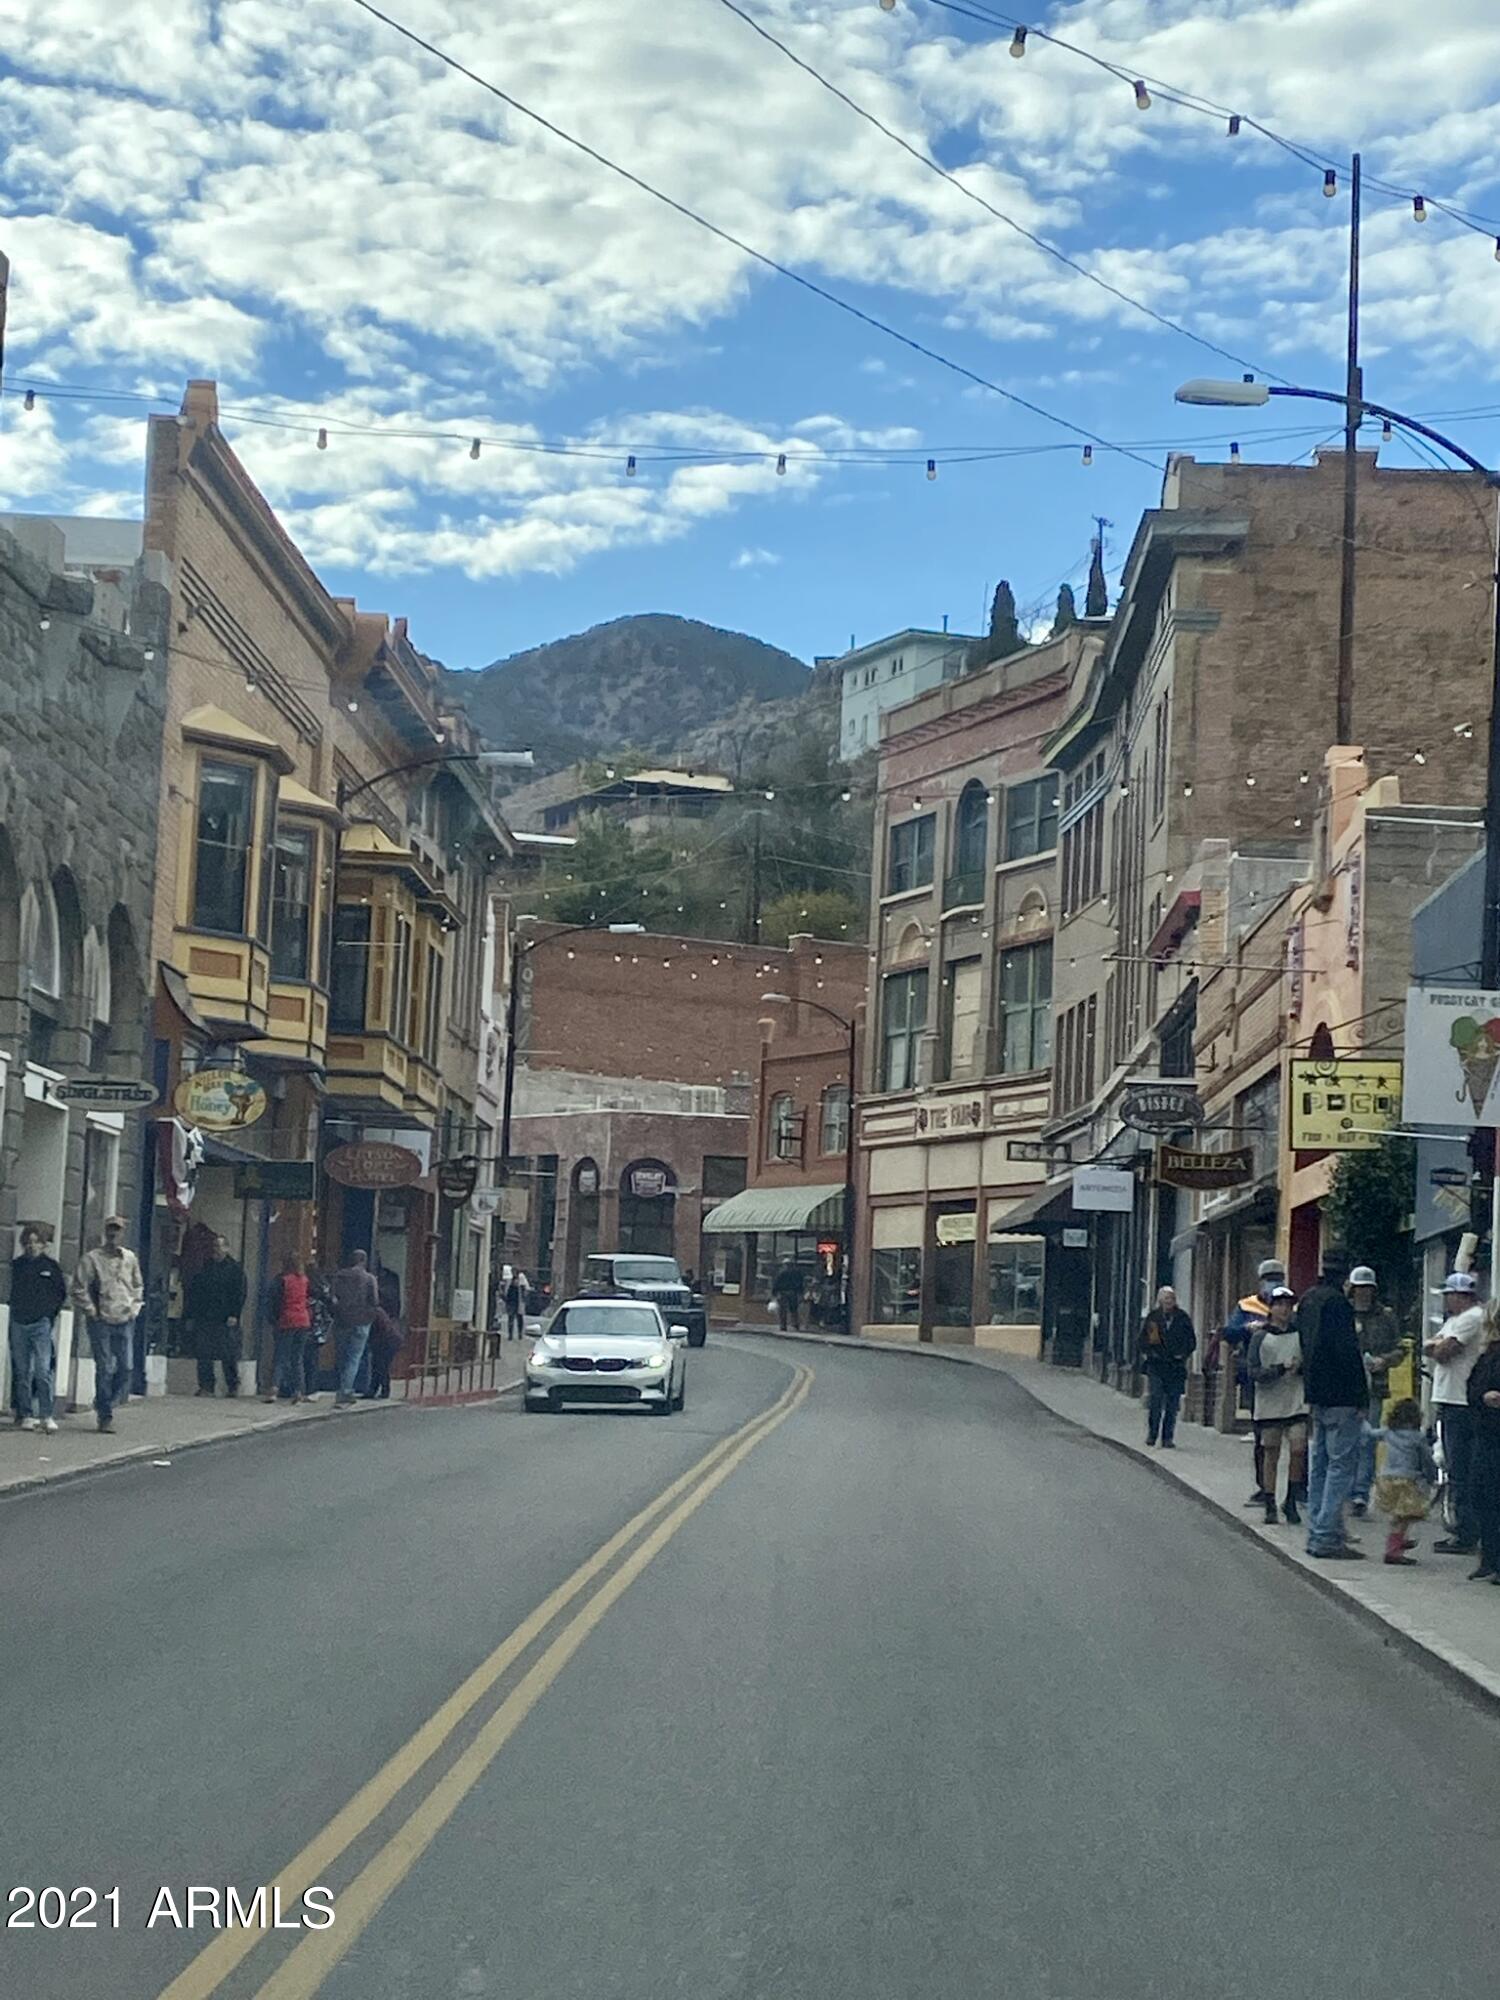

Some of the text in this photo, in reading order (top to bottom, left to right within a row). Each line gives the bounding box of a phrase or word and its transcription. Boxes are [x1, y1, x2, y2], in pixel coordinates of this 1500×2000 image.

[56, 1085, 153, 1101] SINGLETREE
[191, 1095, 232, 1116] Honey
[1138, 1096, 1184, 1112] BISBEE
[930, 1104, 973, 1129] THE FAIR
[1168, 1155, 1247, 1170] BELLEZA
[349, 1172, 395, 1182] HOTEL
